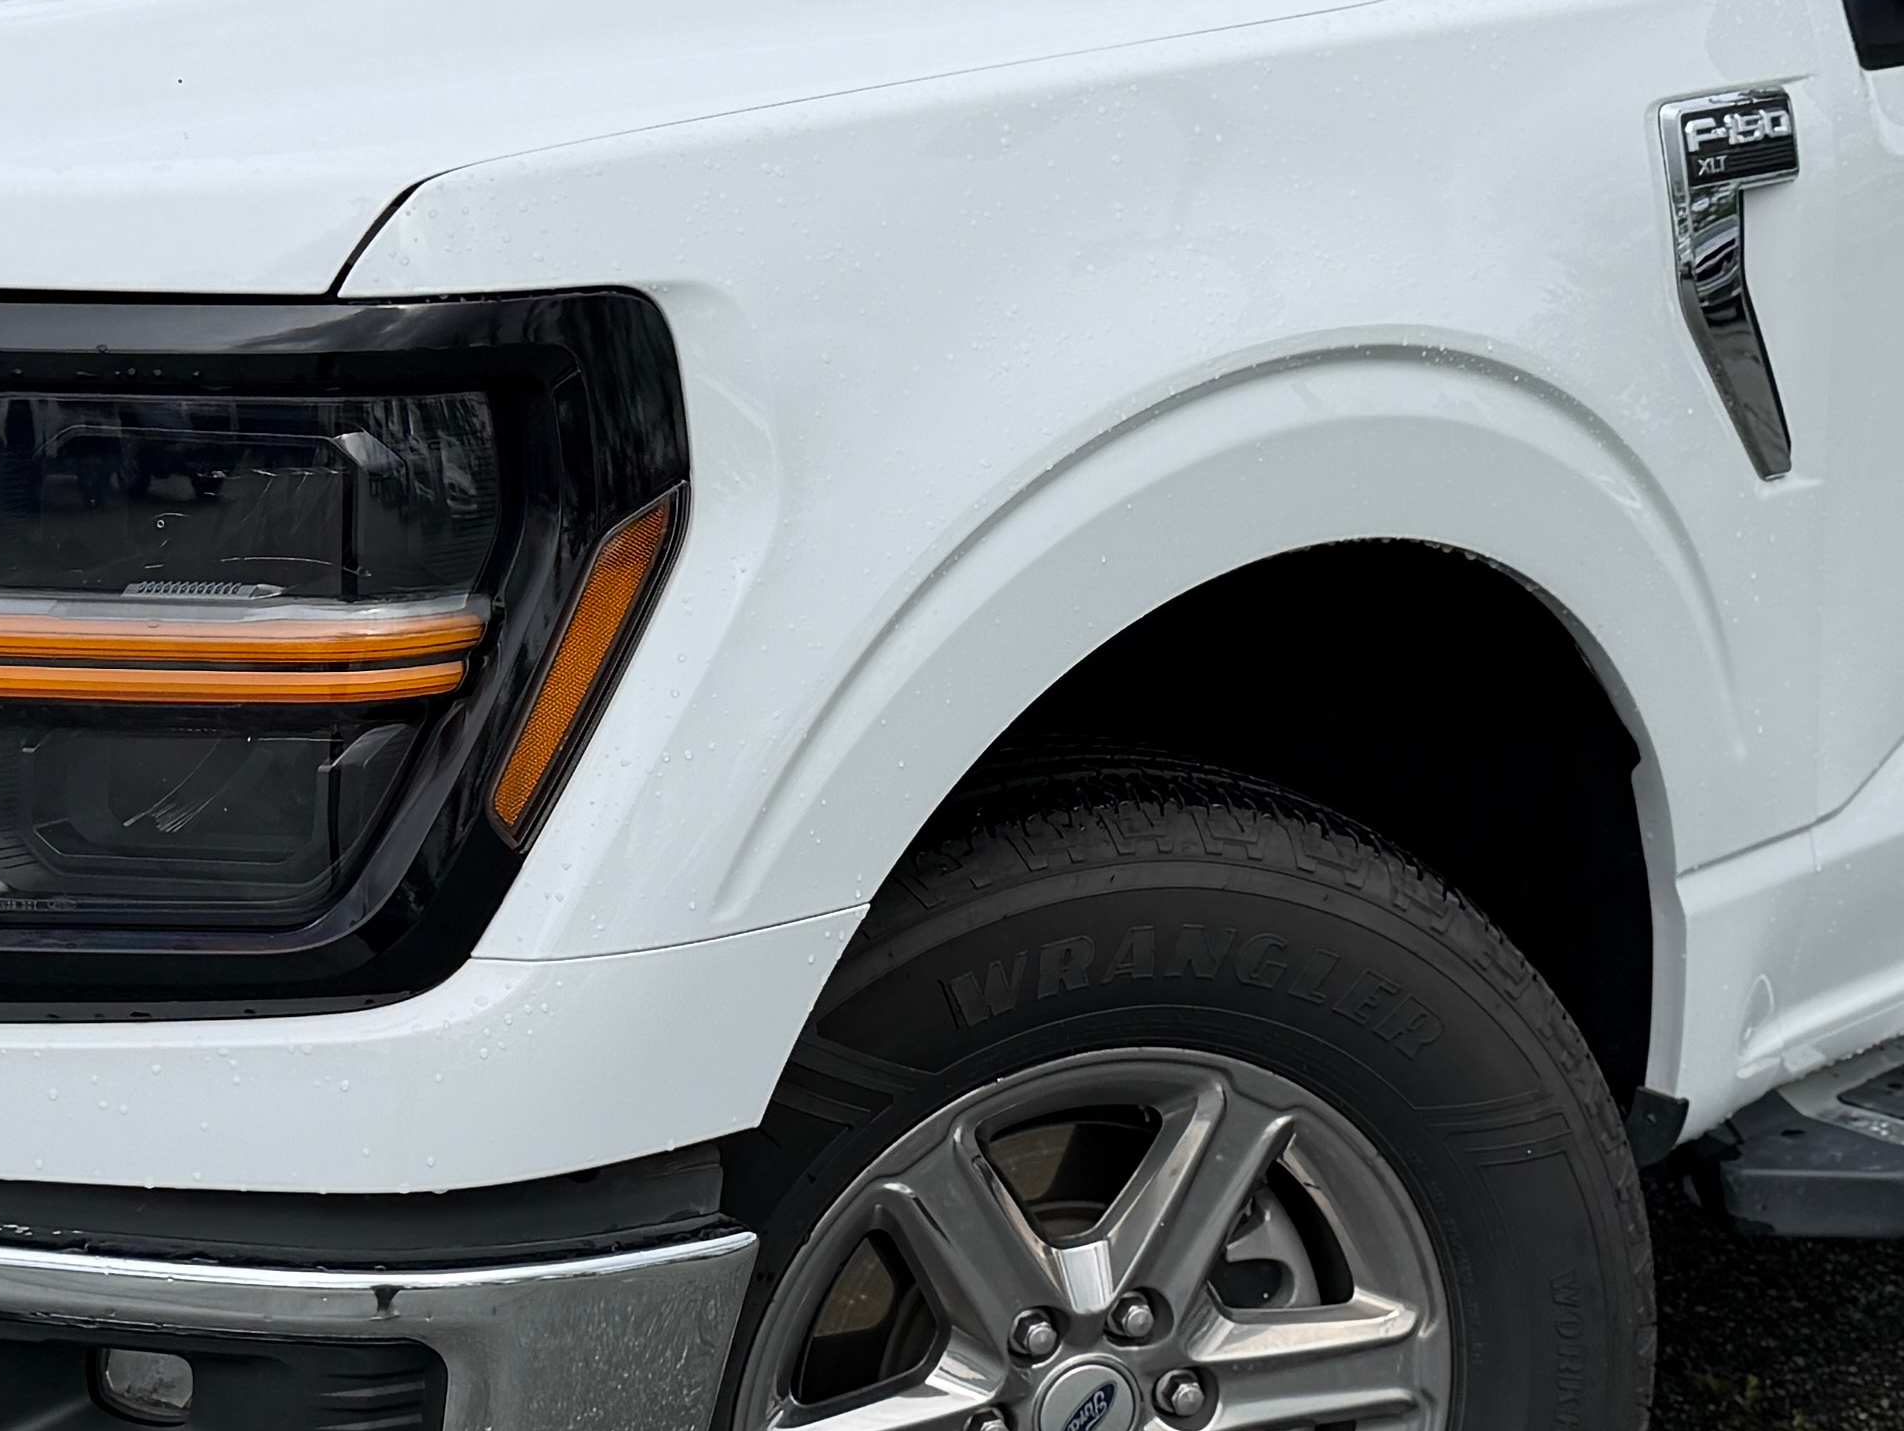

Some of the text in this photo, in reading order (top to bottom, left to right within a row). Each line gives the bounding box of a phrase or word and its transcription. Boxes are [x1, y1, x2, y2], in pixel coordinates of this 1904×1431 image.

[1685, 109, 1792, 152] F-150
[1698, 155, 1728, 176] XLT
[940, 921, 1444, 1060] WRANGLER
